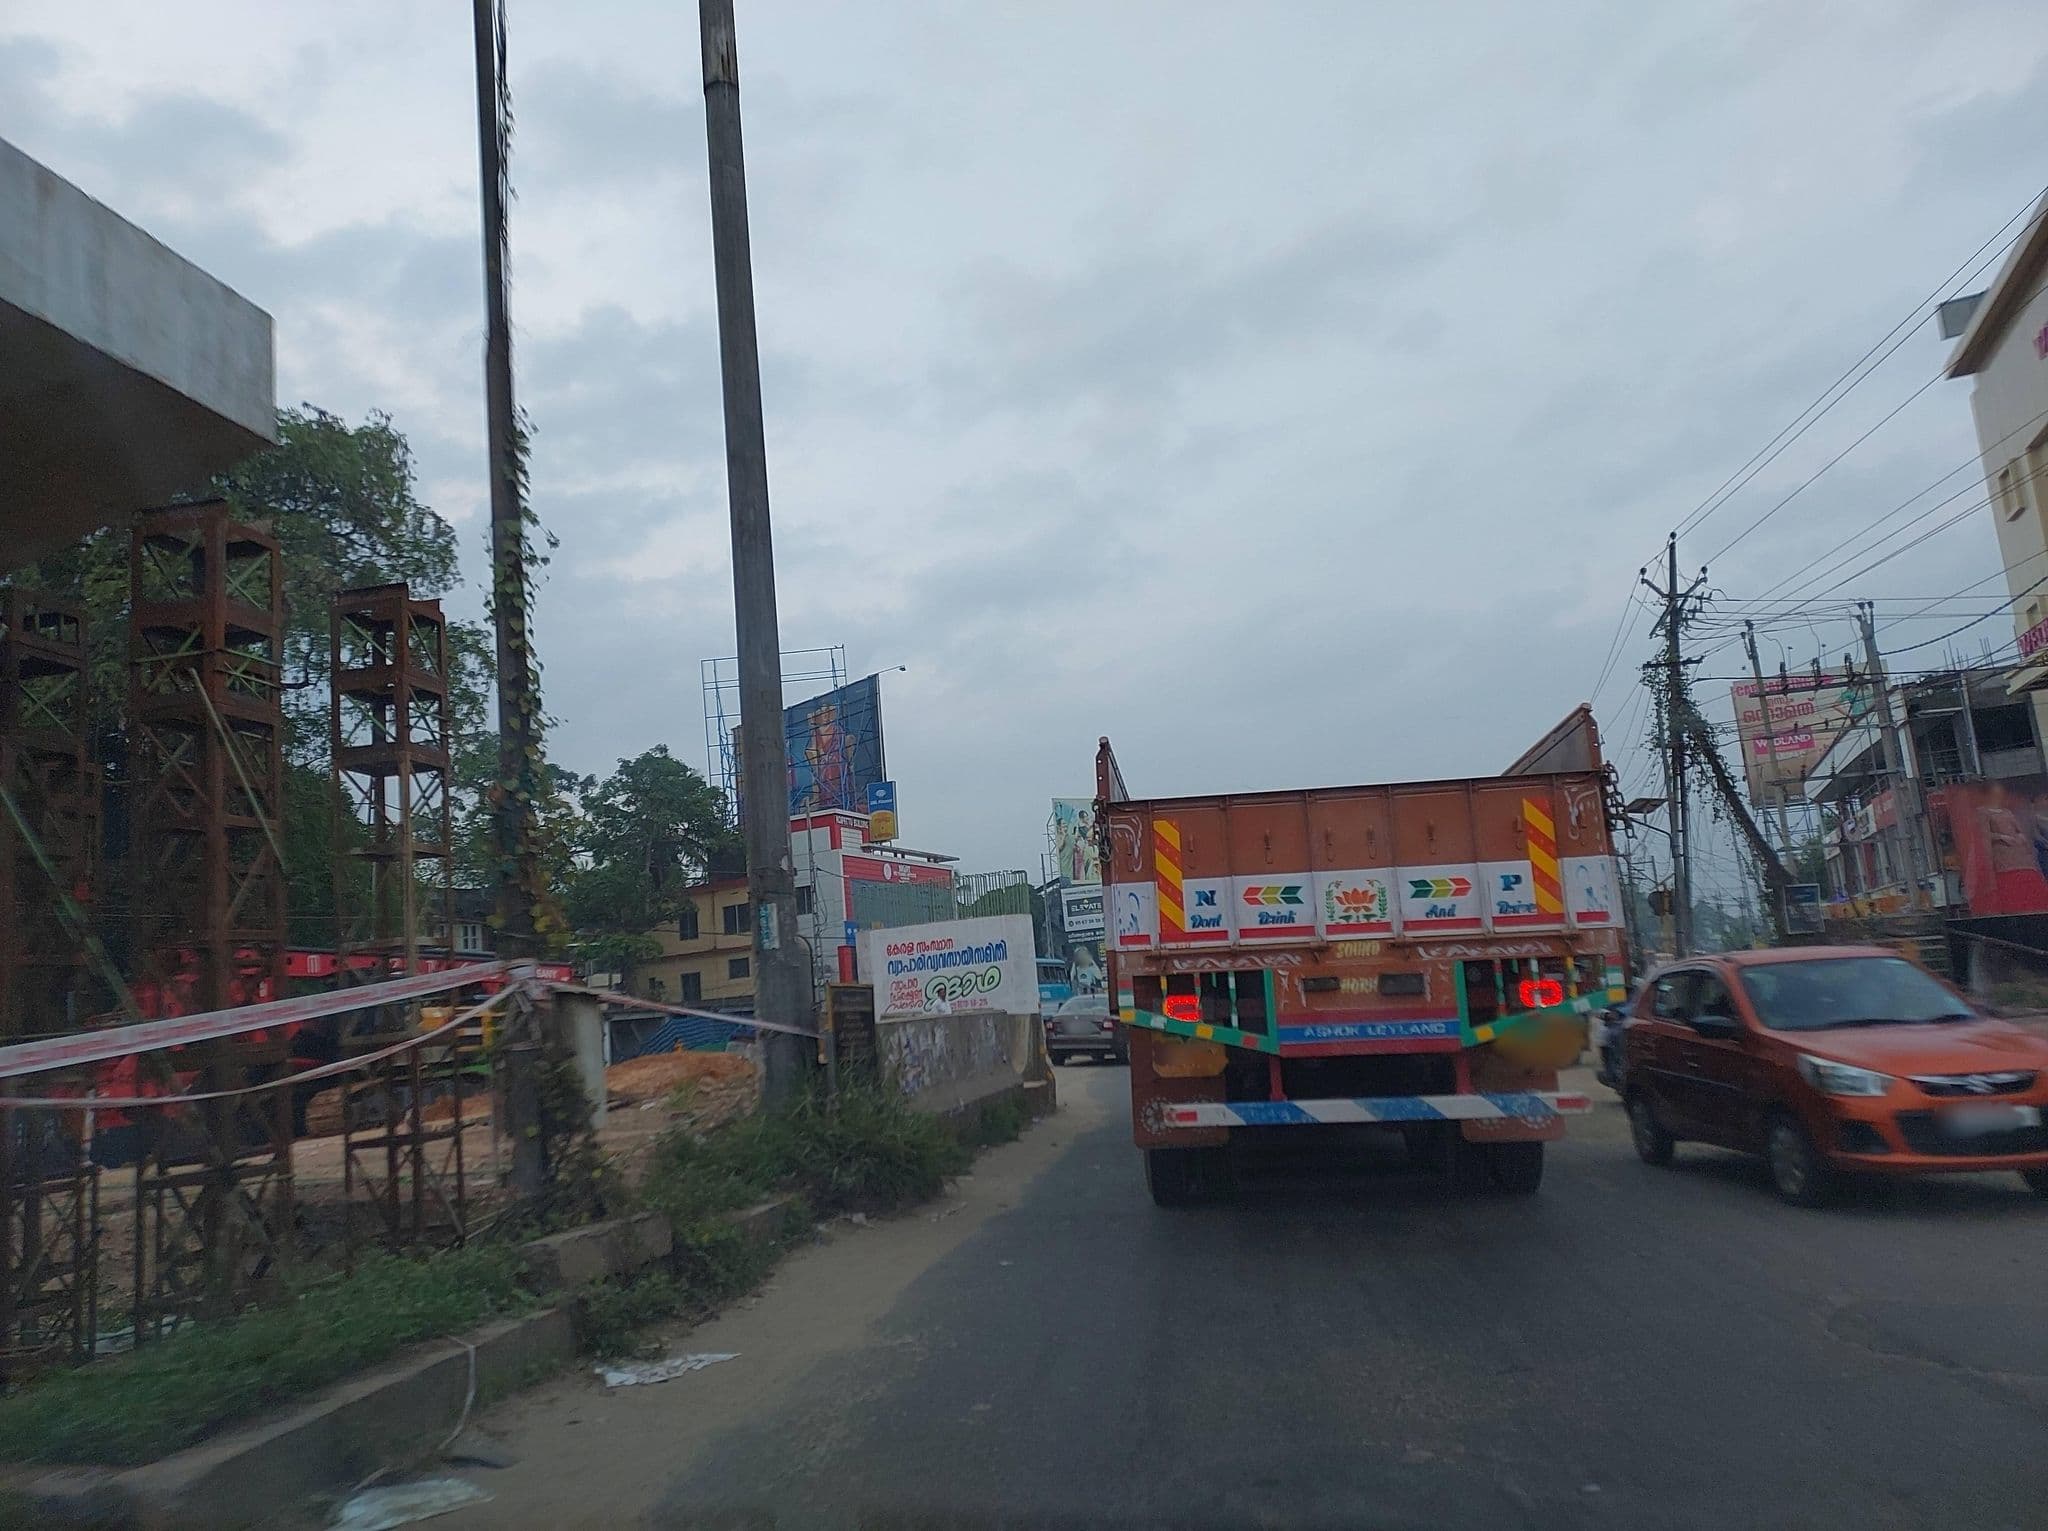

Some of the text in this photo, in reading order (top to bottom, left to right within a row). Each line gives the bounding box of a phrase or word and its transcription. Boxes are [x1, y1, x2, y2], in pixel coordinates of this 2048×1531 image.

[1755, 733, 1811, 748] WDLAND
[1500, 874, 1523, 892] P
[1195, 889, 1217, 907] N
[1071, 903, 1102, 912] ELEVATE
[1258, 910, 1297, 925] Drink
[1425, 903, 1457, 918] And
[1496, 900, 1537, 915] Drive
[886, 942, 915, 956] കേരള
[1336, 940, 1380, 958] SOUND
[1304, 1022, 1447, 1038] ASHOK LEYLAND
